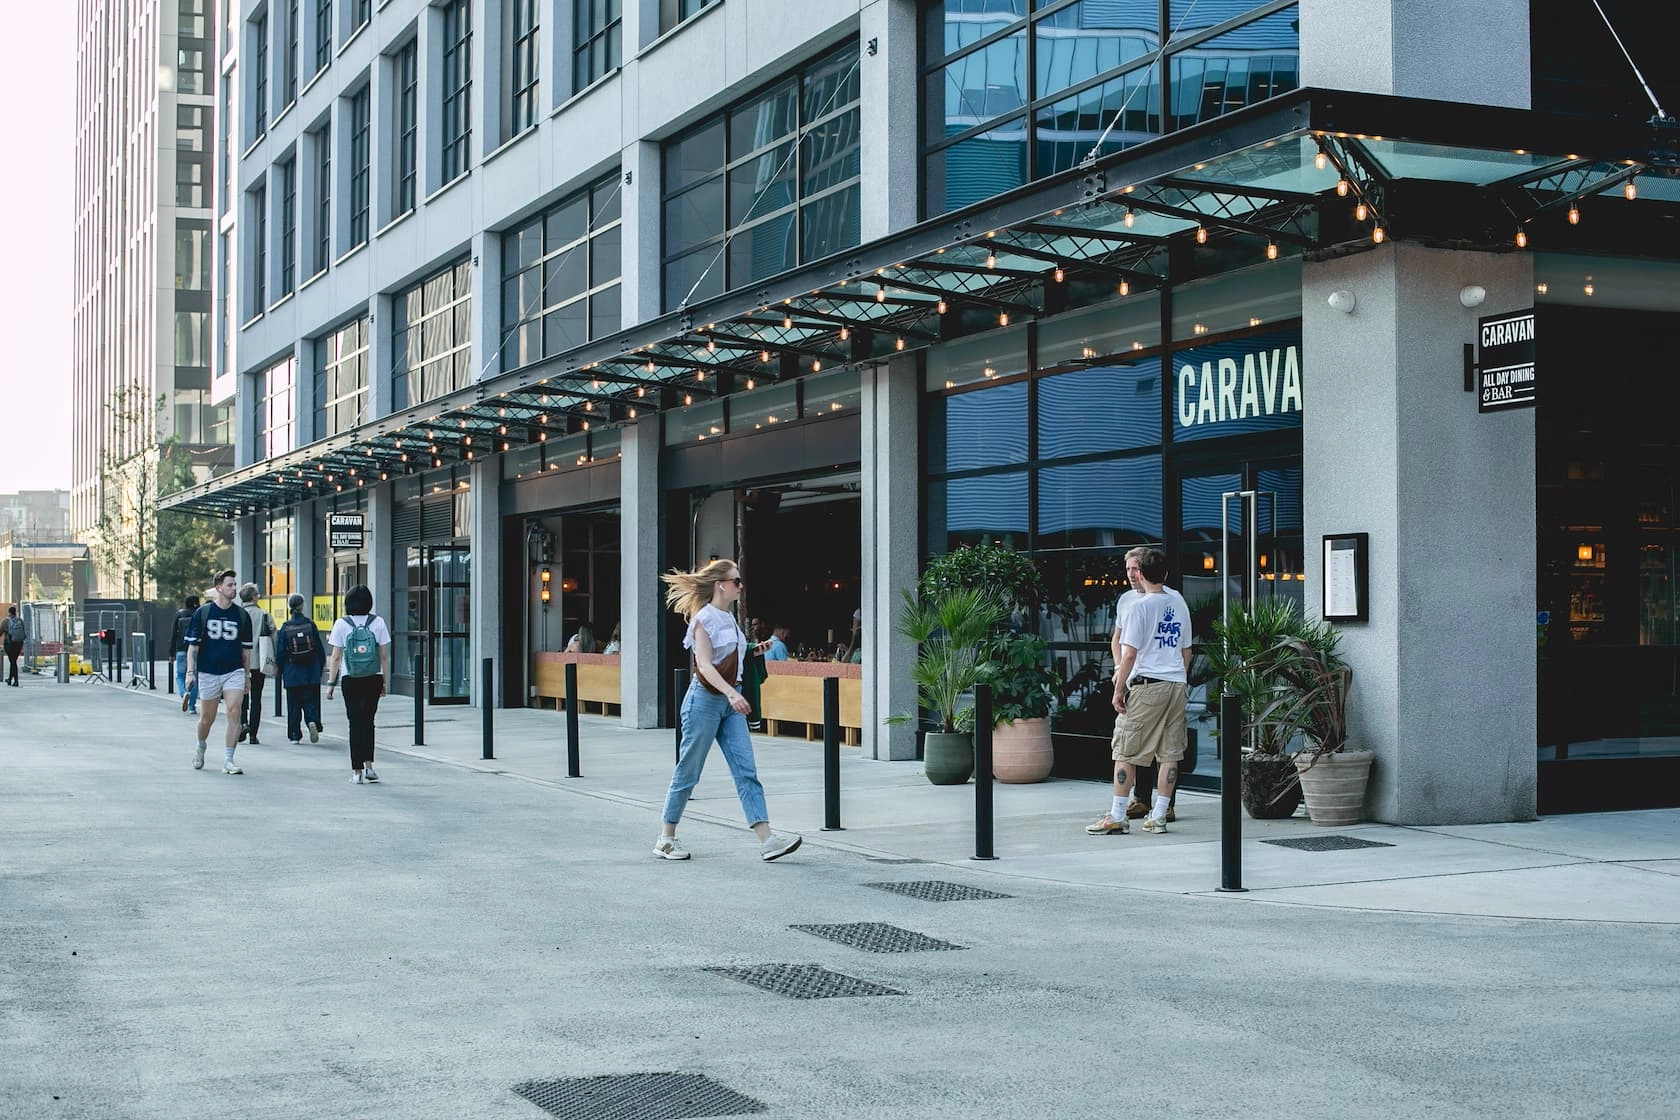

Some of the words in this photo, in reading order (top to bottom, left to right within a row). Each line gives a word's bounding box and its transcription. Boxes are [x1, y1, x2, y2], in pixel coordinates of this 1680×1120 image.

[1482, 319, 1534, 347] CARAVAN
[1483, 374, 1495, 387] ALL
[1496, 371, 1509, 385] DAY
[1510, 367, 1534, 383] DINING
[1179, 346, 1302, 427] CARAVA
[1483, 388, 1490, 401] &
[1491, 386, 1512, 400] BAR
[332, 517, 362, 525] CARAVAN
[207, 619, 238, 640] 95
[1158, 622, 1181, 637] FEAR
[1154, 635, 1178, 648] THIS
